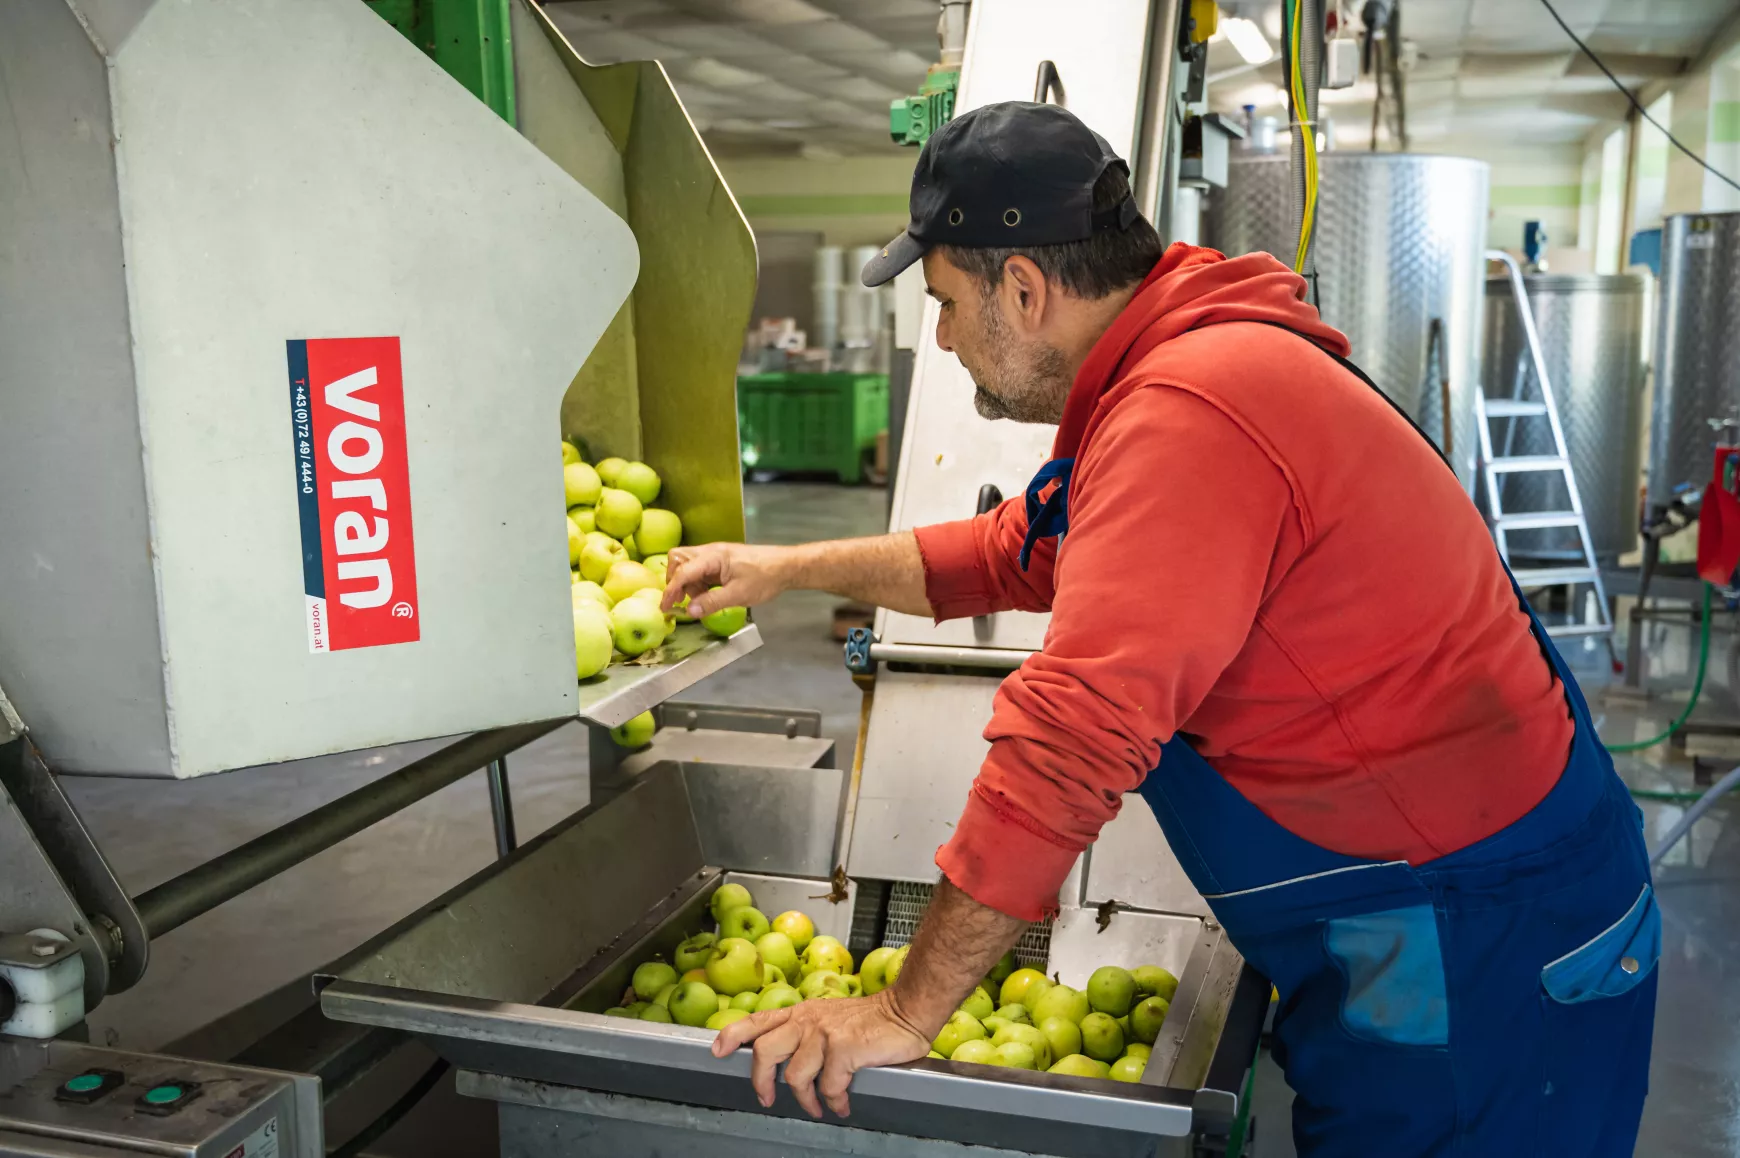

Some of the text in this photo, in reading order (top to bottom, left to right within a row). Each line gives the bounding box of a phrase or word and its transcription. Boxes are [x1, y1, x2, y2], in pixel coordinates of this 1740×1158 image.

[301, 462, 314, 494] 444-0
[325, 366, 394, 609] voran
[312, 603, 324, 649] voran.at
